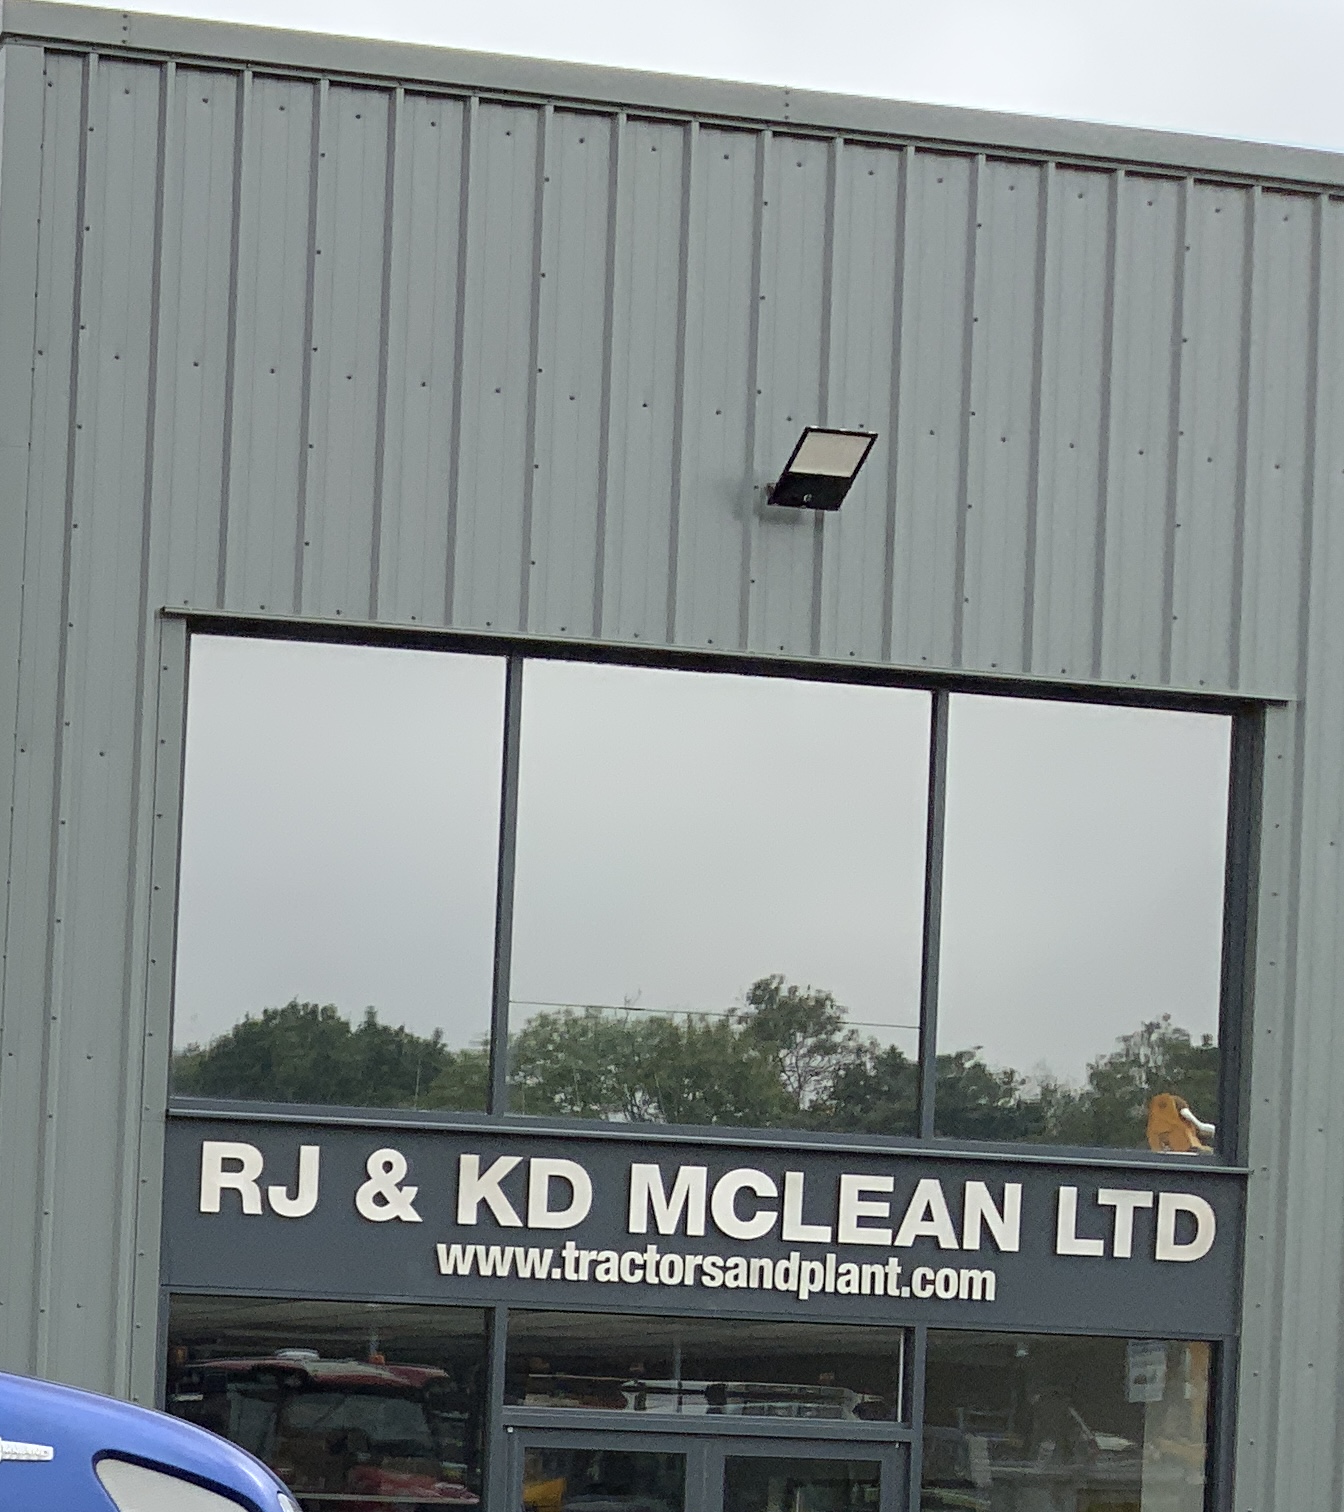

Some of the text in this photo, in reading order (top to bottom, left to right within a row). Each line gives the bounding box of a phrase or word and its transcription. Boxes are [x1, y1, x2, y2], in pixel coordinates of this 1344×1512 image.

[199, 1141, 1217, 1263] RJ & KD MCLEAN LTD
[436, 1240, 997, 1301] www.tractorsandplant.com
